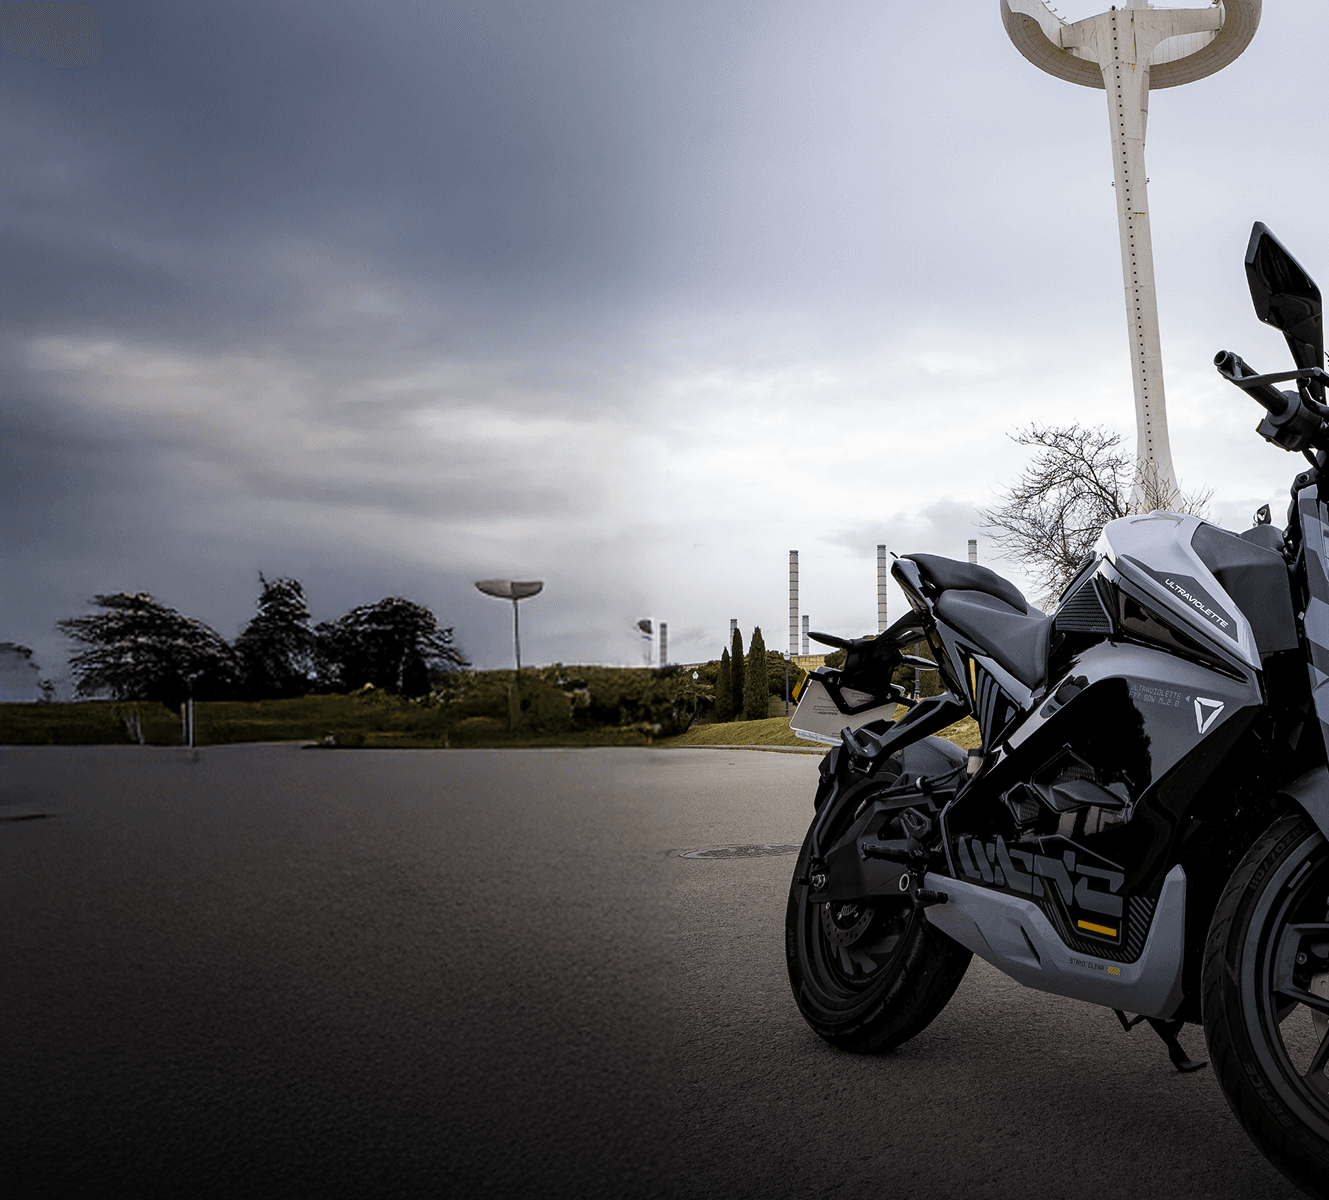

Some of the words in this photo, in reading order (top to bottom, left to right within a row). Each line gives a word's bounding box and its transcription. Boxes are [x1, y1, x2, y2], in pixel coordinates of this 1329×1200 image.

[1165, 578, 1229, 628] ULTRAVIOLETTE
[1128, 691, 1141, 700] F77
[1130, 684, 1182, 700] ULTRAVIOLETTE
[1070, 957, 1086, 967] STAND
[1087, 961, 1105, 971] CLEAR
[1243, 1062, 1295, 1128] BRACE
